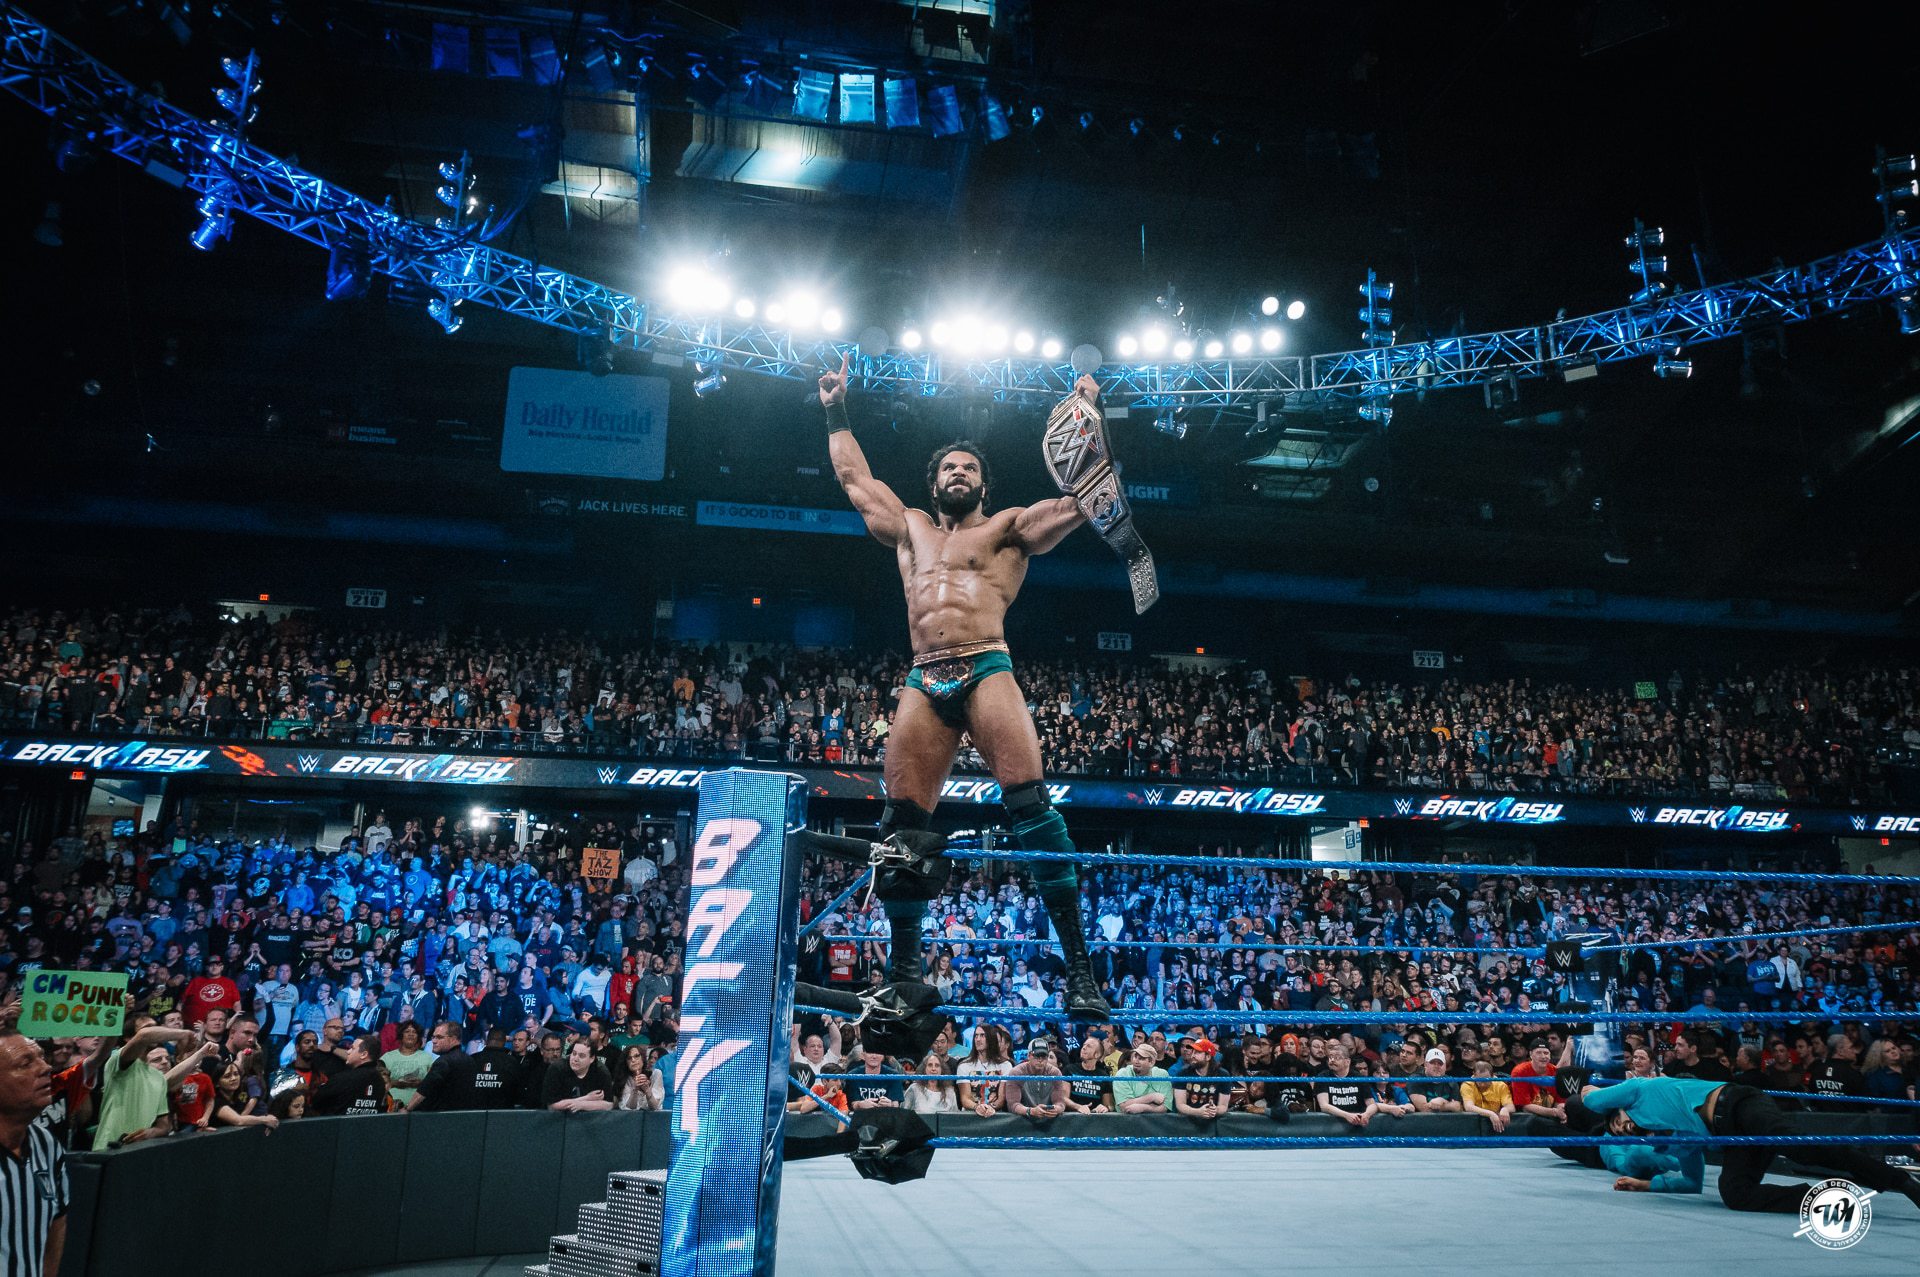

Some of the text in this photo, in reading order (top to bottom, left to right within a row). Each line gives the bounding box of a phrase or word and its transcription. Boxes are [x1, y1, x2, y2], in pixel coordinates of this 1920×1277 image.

[520, 401, 652, 434] Daily Herald
[577, 499, 609, 511] JACK
[612, 501, 648, 514] LIVES
[728, 506, 769, 519] GOOD
[770, 508, 786, 520] TO
[1418, 656, 1440, 667] 212
[594, 849, 608, 860] THE
[588, 857, 612, 869] TAZ
[587, 868, 612, 877] SHOW
[33, 974, 68, 994] CM
[67, 981, 126, 1006] PUNK
[31, 1001, 118, 1027] ROCKS
[476, 1073, 498, 1081] EVENT
[474, 1080, 502, 1088] ECURITY
[1815, 1079, 1844, 1090] EVENT
[354, 1098, 377, 1108] EVENT
